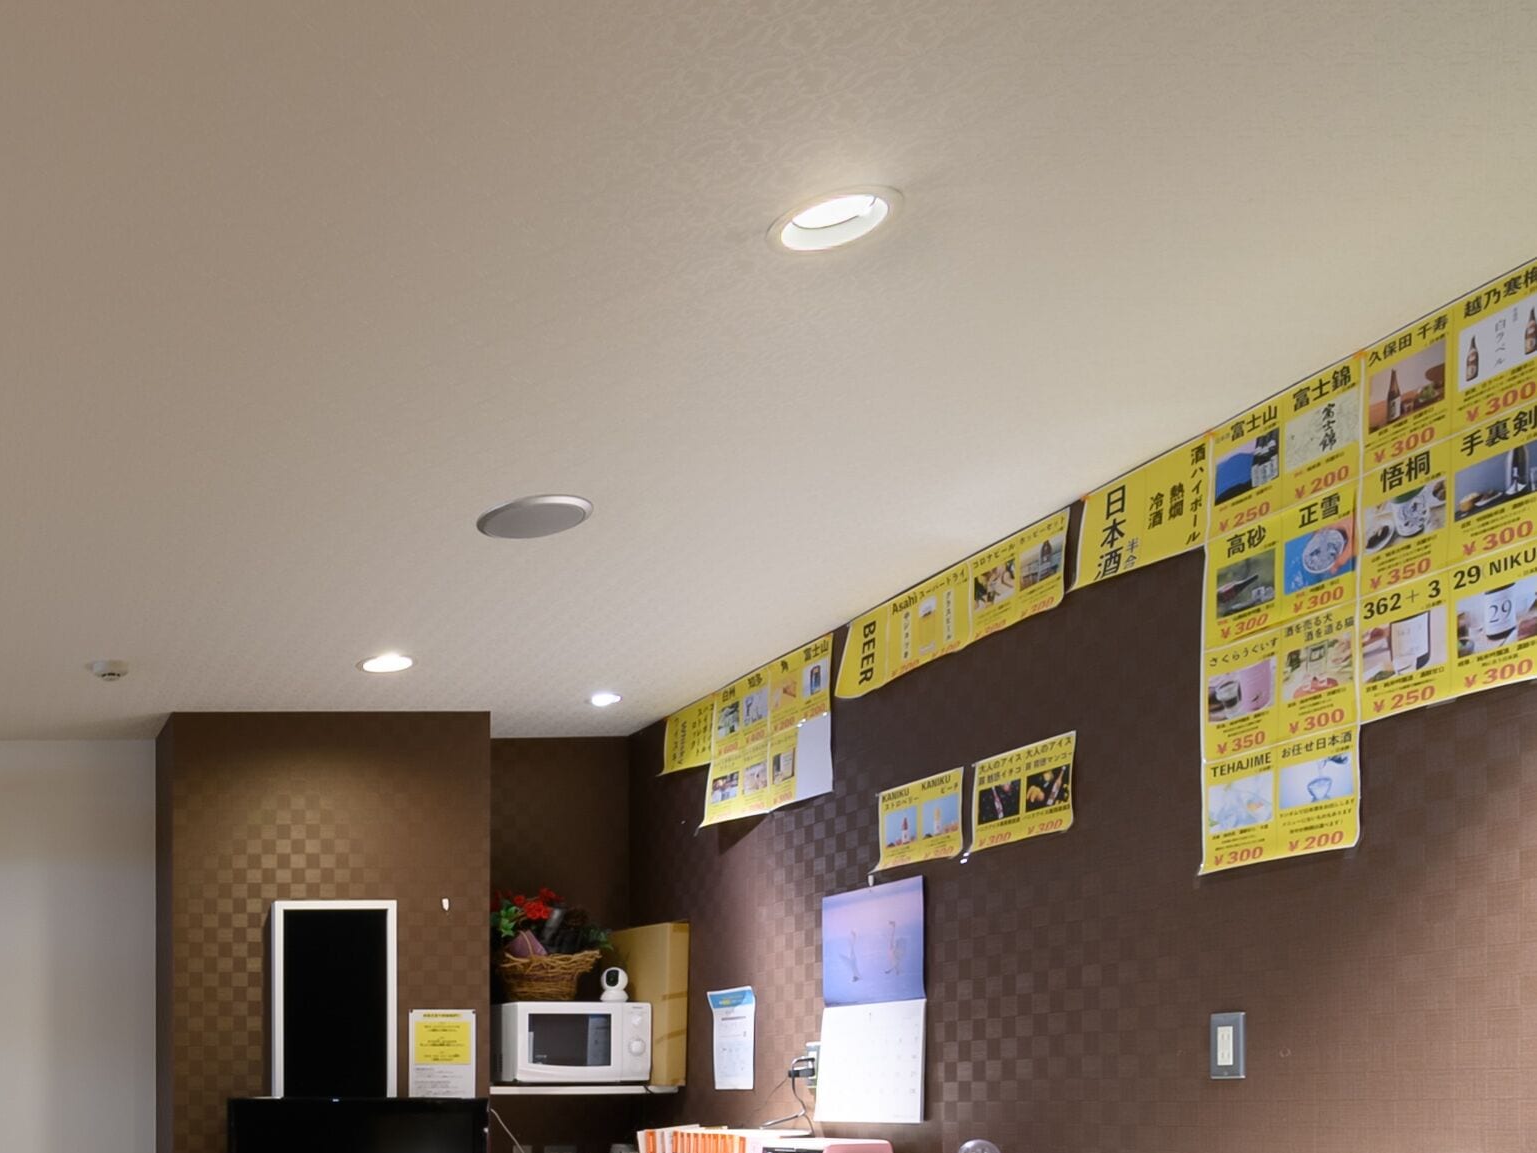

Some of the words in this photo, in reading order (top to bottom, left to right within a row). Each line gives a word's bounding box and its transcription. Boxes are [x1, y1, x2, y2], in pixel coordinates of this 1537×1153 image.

[1368, 333, 1412, 367] 久保田
[1417, 314, 1449, 339] 千寿
[1293, 365, 1352, 412] 富士錦
[1230, 405, 1278, 441] 富士山
[1380, 450, 1431, 493] 悟桐
[1147, 491, 1165, 530] 冷酒
[1185, 443, 1207, 545] 酒ハイボール
[1298, 493, 1341, 529] 正雪
[1094, 484, 1127, 581] 日本酒
[1226, 525, 1267, 558] 高砂
[892, 593, 918, 615] Asahi
[1363, 593, 1401, 620] 362
[1488, 599, 1512, 623] 29
[858, 620, 877, 685] BEER
[1209, 637, 1278, 667] さくらうぐいす
[1281, 731, 1352, 759] お任せ日本酒
[1211, 752, 1272, 777] TEHAJIME
